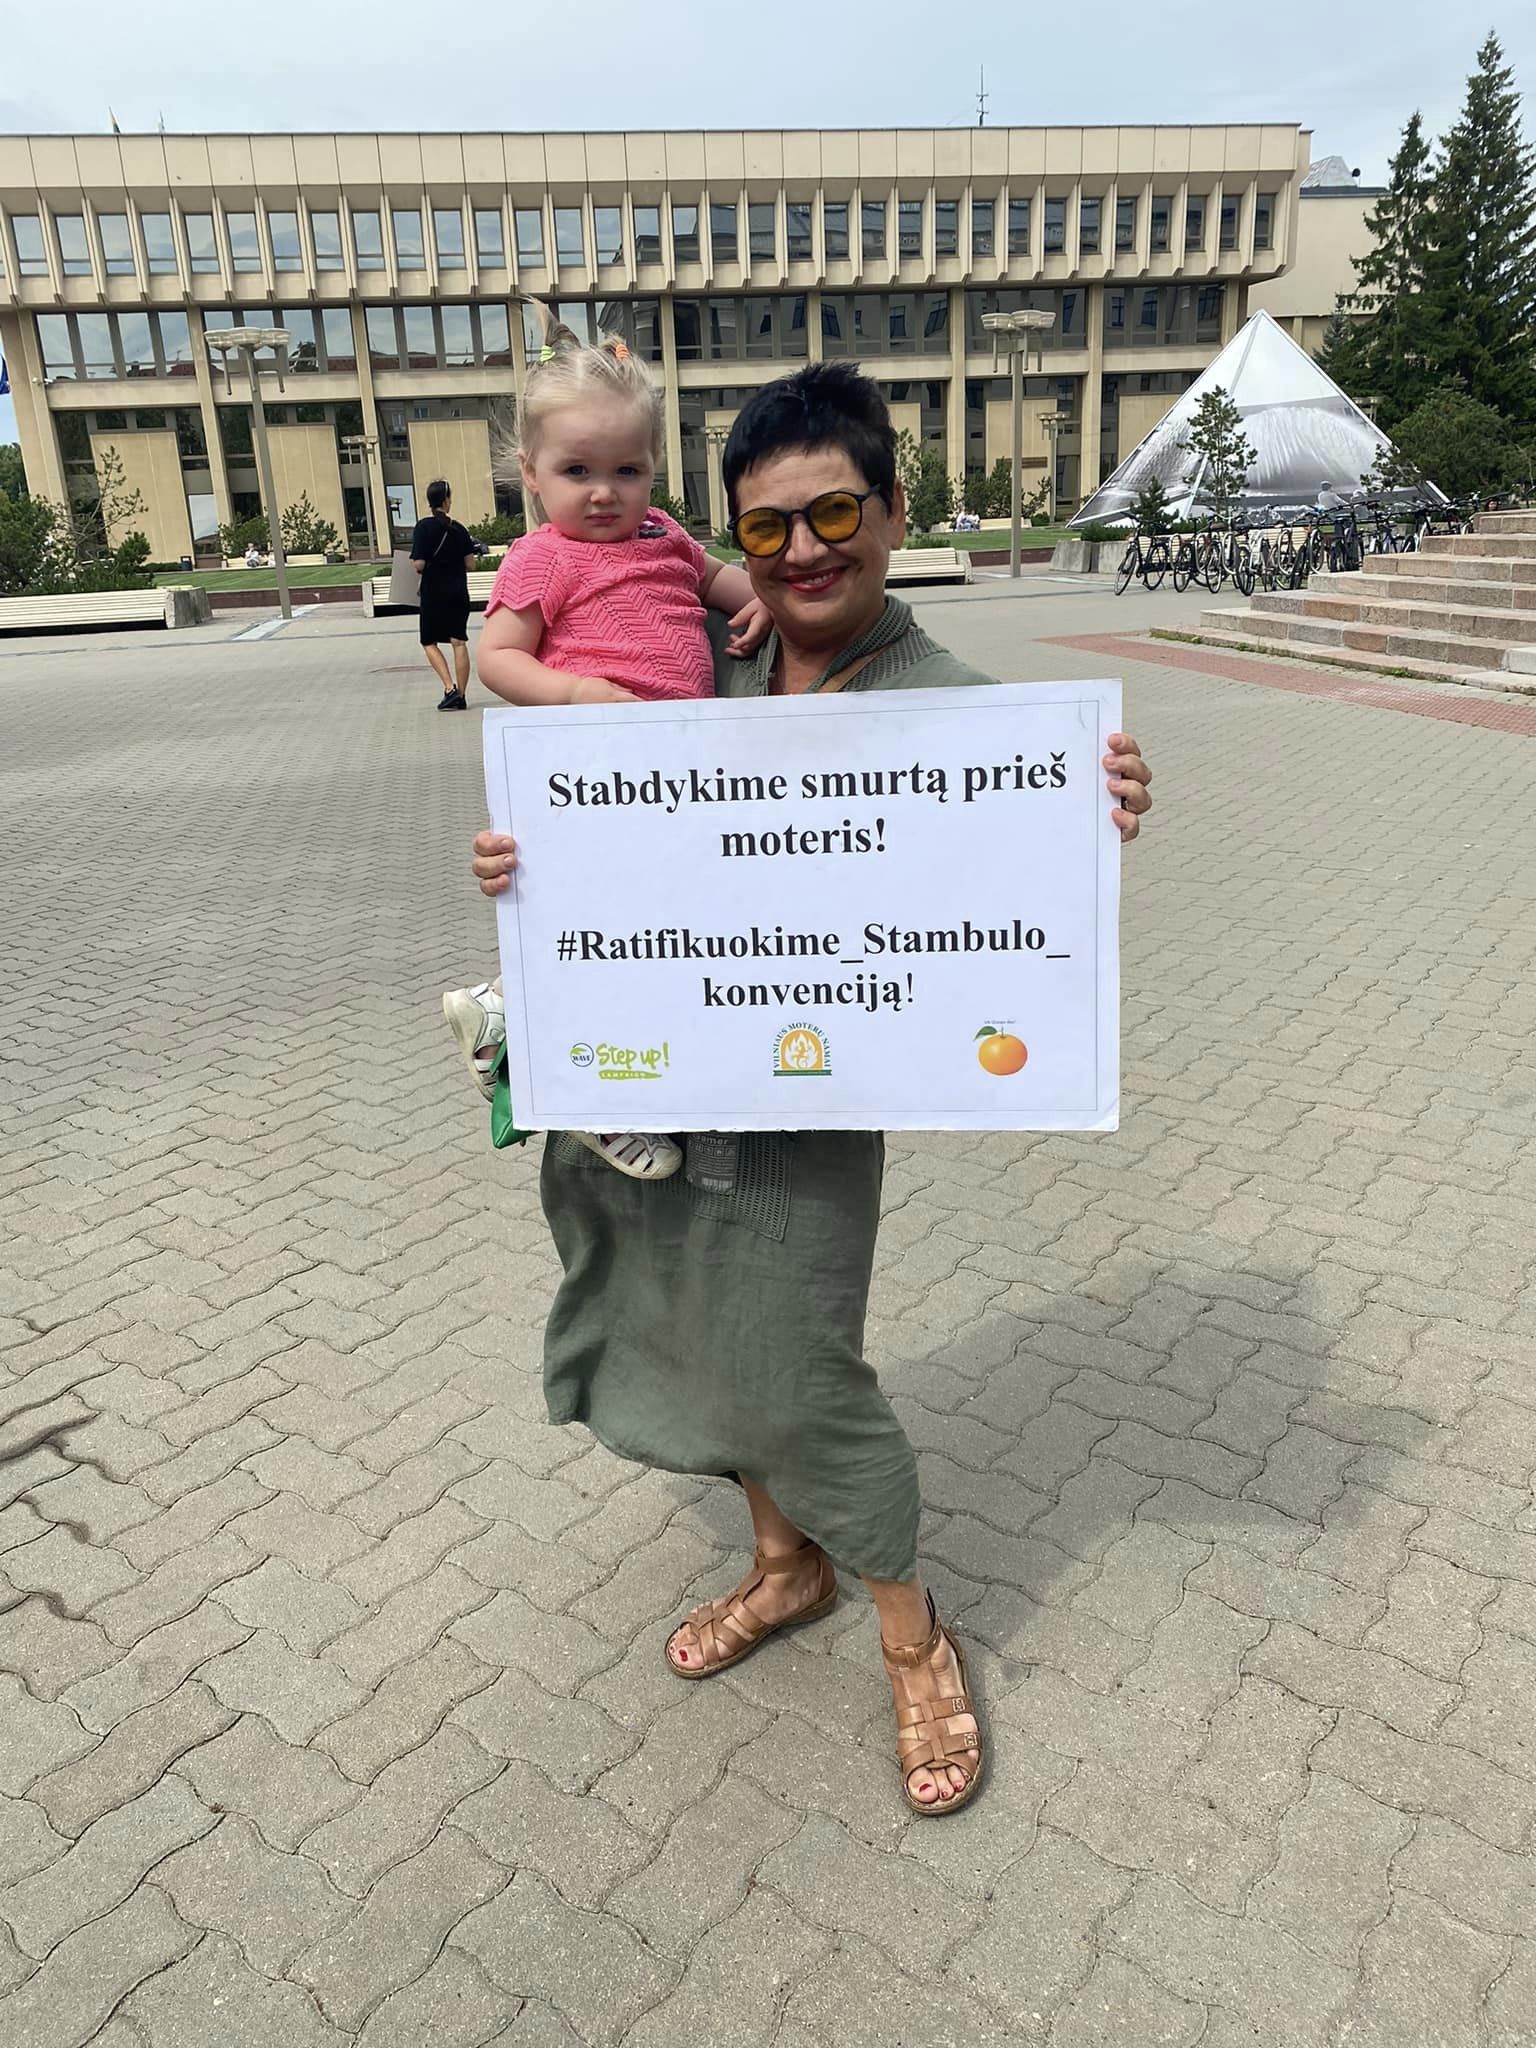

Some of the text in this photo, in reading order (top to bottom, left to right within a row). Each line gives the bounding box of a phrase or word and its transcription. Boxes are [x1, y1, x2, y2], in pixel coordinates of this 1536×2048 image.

[548, 750, 1067, 814] Stabdykime smurtą prieš
[721, 818, 886, 858] moteris!
[556, 919, 1071, 965] #Ratifikuokime_Stambulo_
[702, 972, 915, 1014] konvenciją!
[595, 1041, 671, 1070] Step up!
[772, 1028, 789, 1068] VILNIAUS
